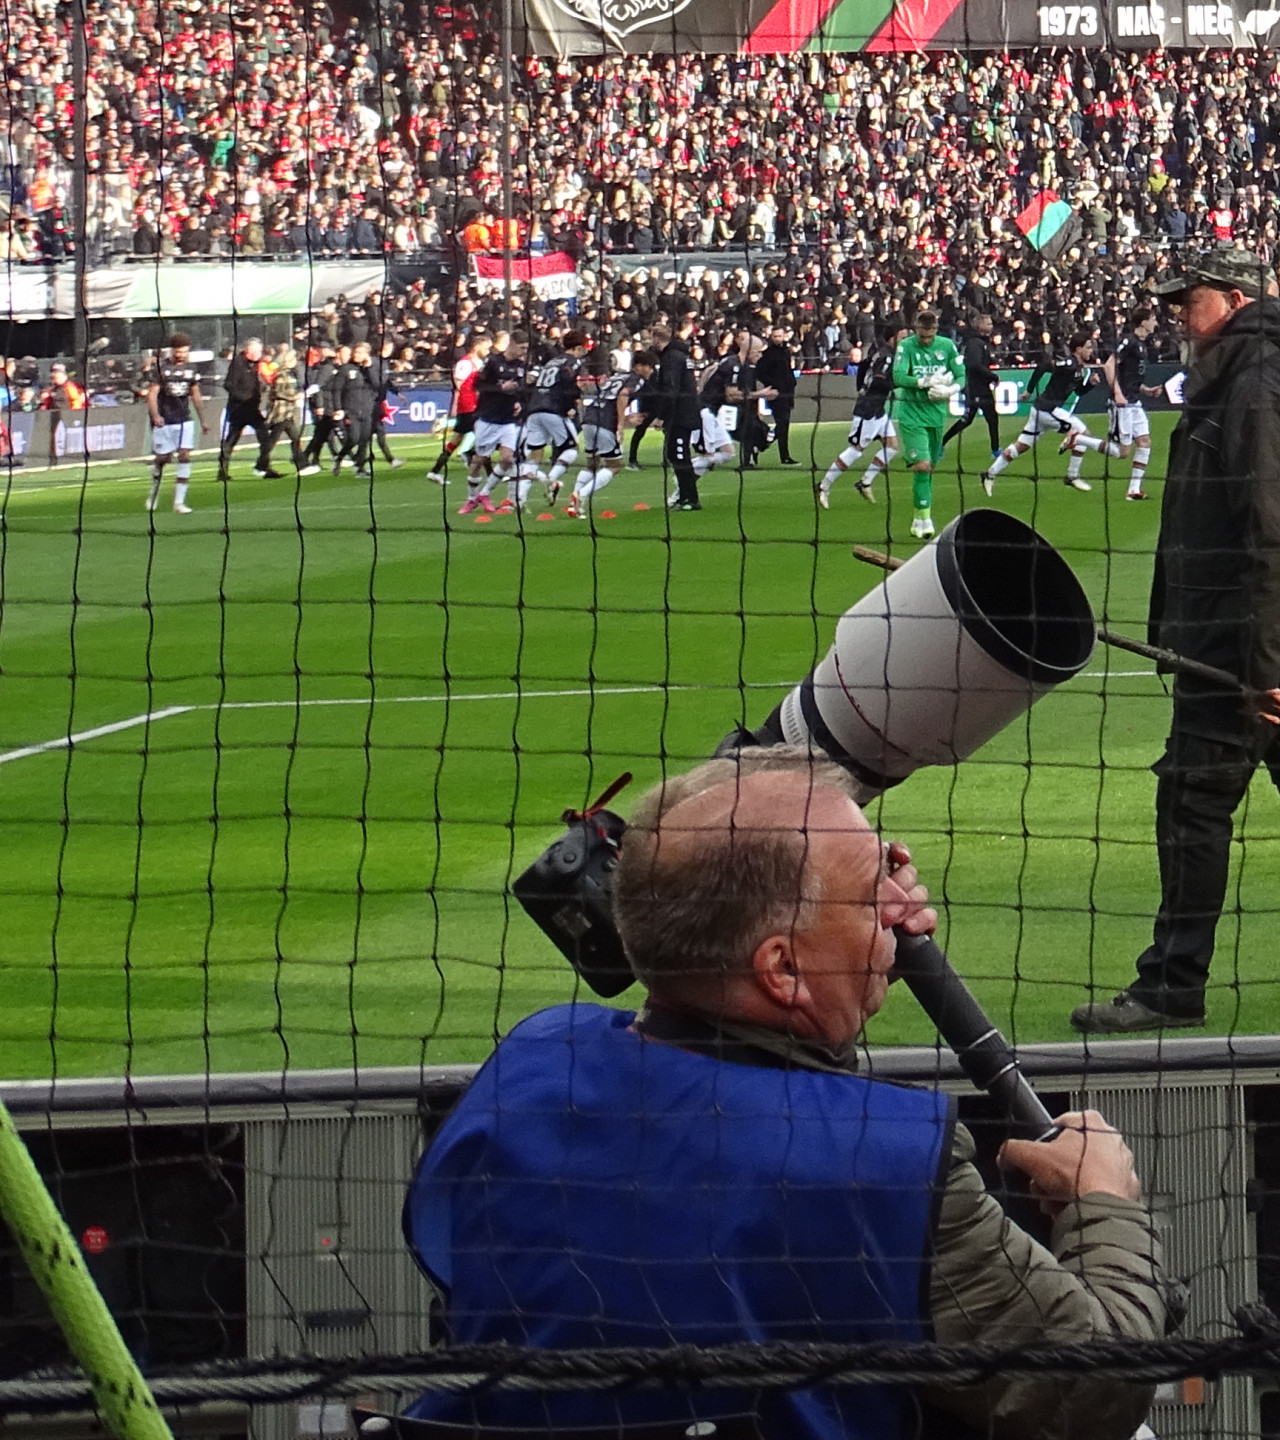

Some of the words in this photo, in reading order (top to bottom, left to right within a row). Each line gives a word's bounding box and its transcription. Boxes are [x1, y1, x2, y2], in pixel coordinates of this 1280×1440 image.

[1039, 6, 1098, 37] 1973
[1117, 6, 1166, 37] NAC
[1188, 6, 1233, 36] NEC
[536, 366, 560, 388] 18
[409, 401, 437, 422] 0.0
